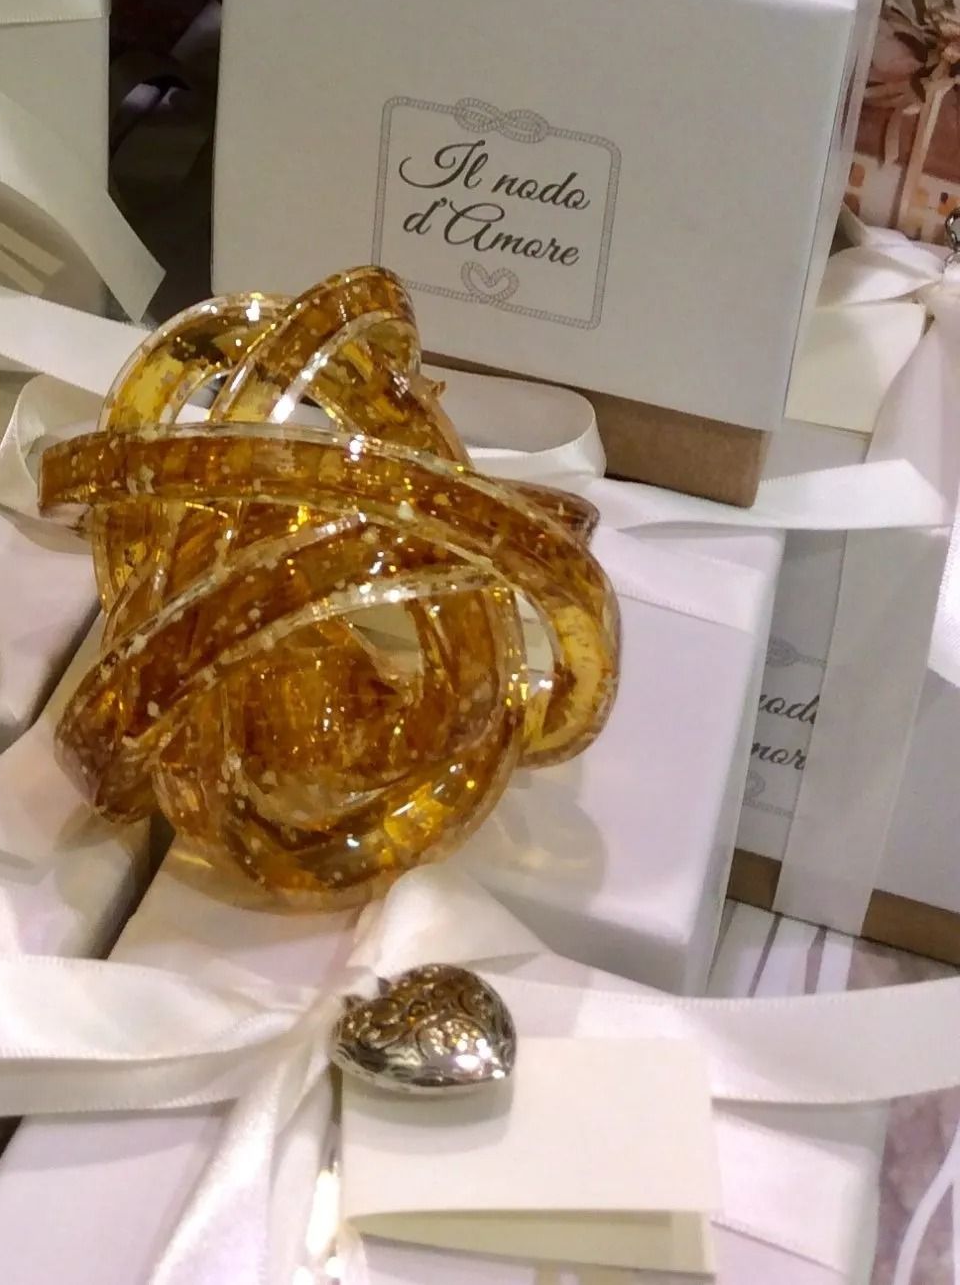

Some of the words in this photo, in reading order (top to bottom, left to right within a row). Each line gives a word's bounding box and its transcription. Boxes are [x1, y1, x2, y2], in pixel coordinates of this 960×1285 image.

[398, 139, 489, 189] Il
[491, 171, 591, 211] nodo
[402, 196, 580, 266] d'Amore
